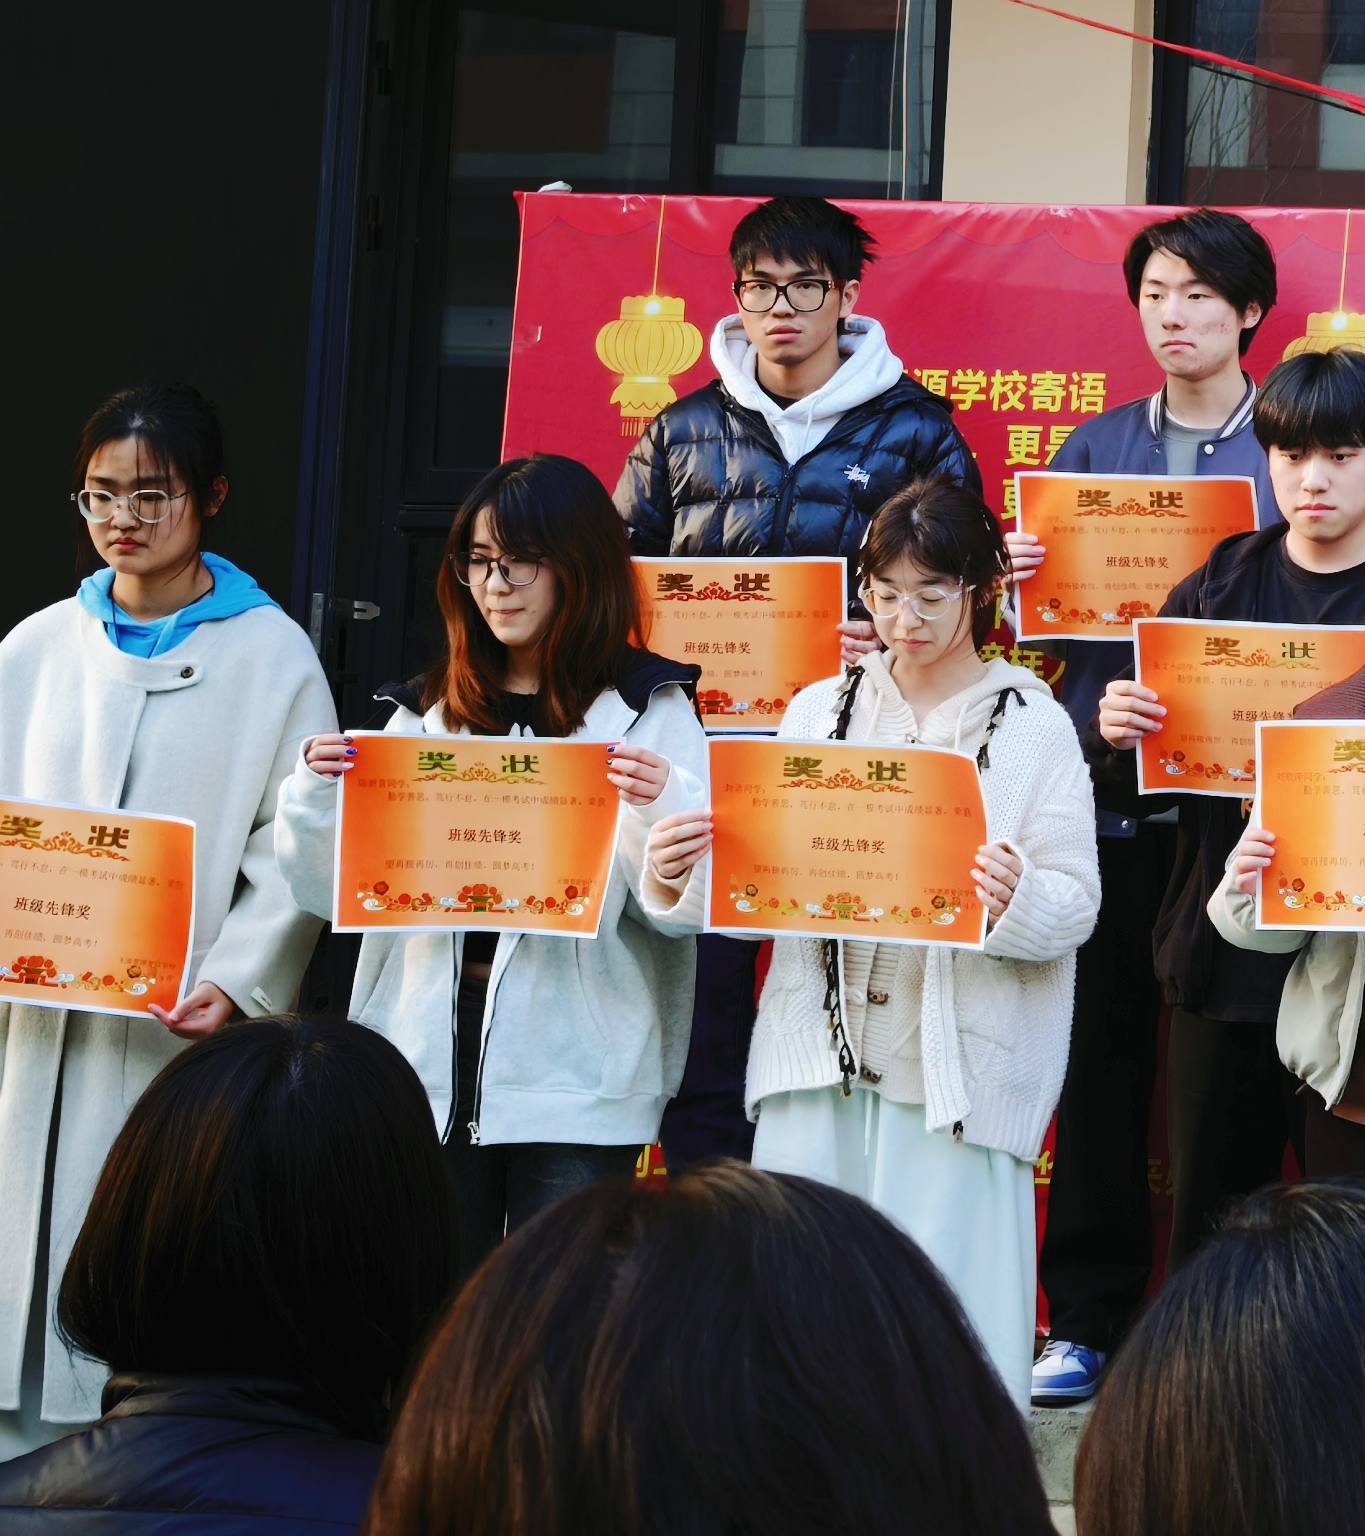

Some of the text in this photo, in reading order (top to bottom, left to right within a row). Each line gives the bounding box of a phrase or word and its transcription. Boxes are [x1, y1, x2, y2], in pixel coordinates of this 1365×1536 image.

[904, 368, 1107, 414] 源学校寄语
[1106, 556, 1169, 569] 班级先锋奖
[684, 641, 751, 655] 班级先锋奖
[447, 827, 522, 844] 班级先锋奖
[811, 836, 886, 854] 班级先锋奖
[14, 896, 91, 920] 班级先锋奖
